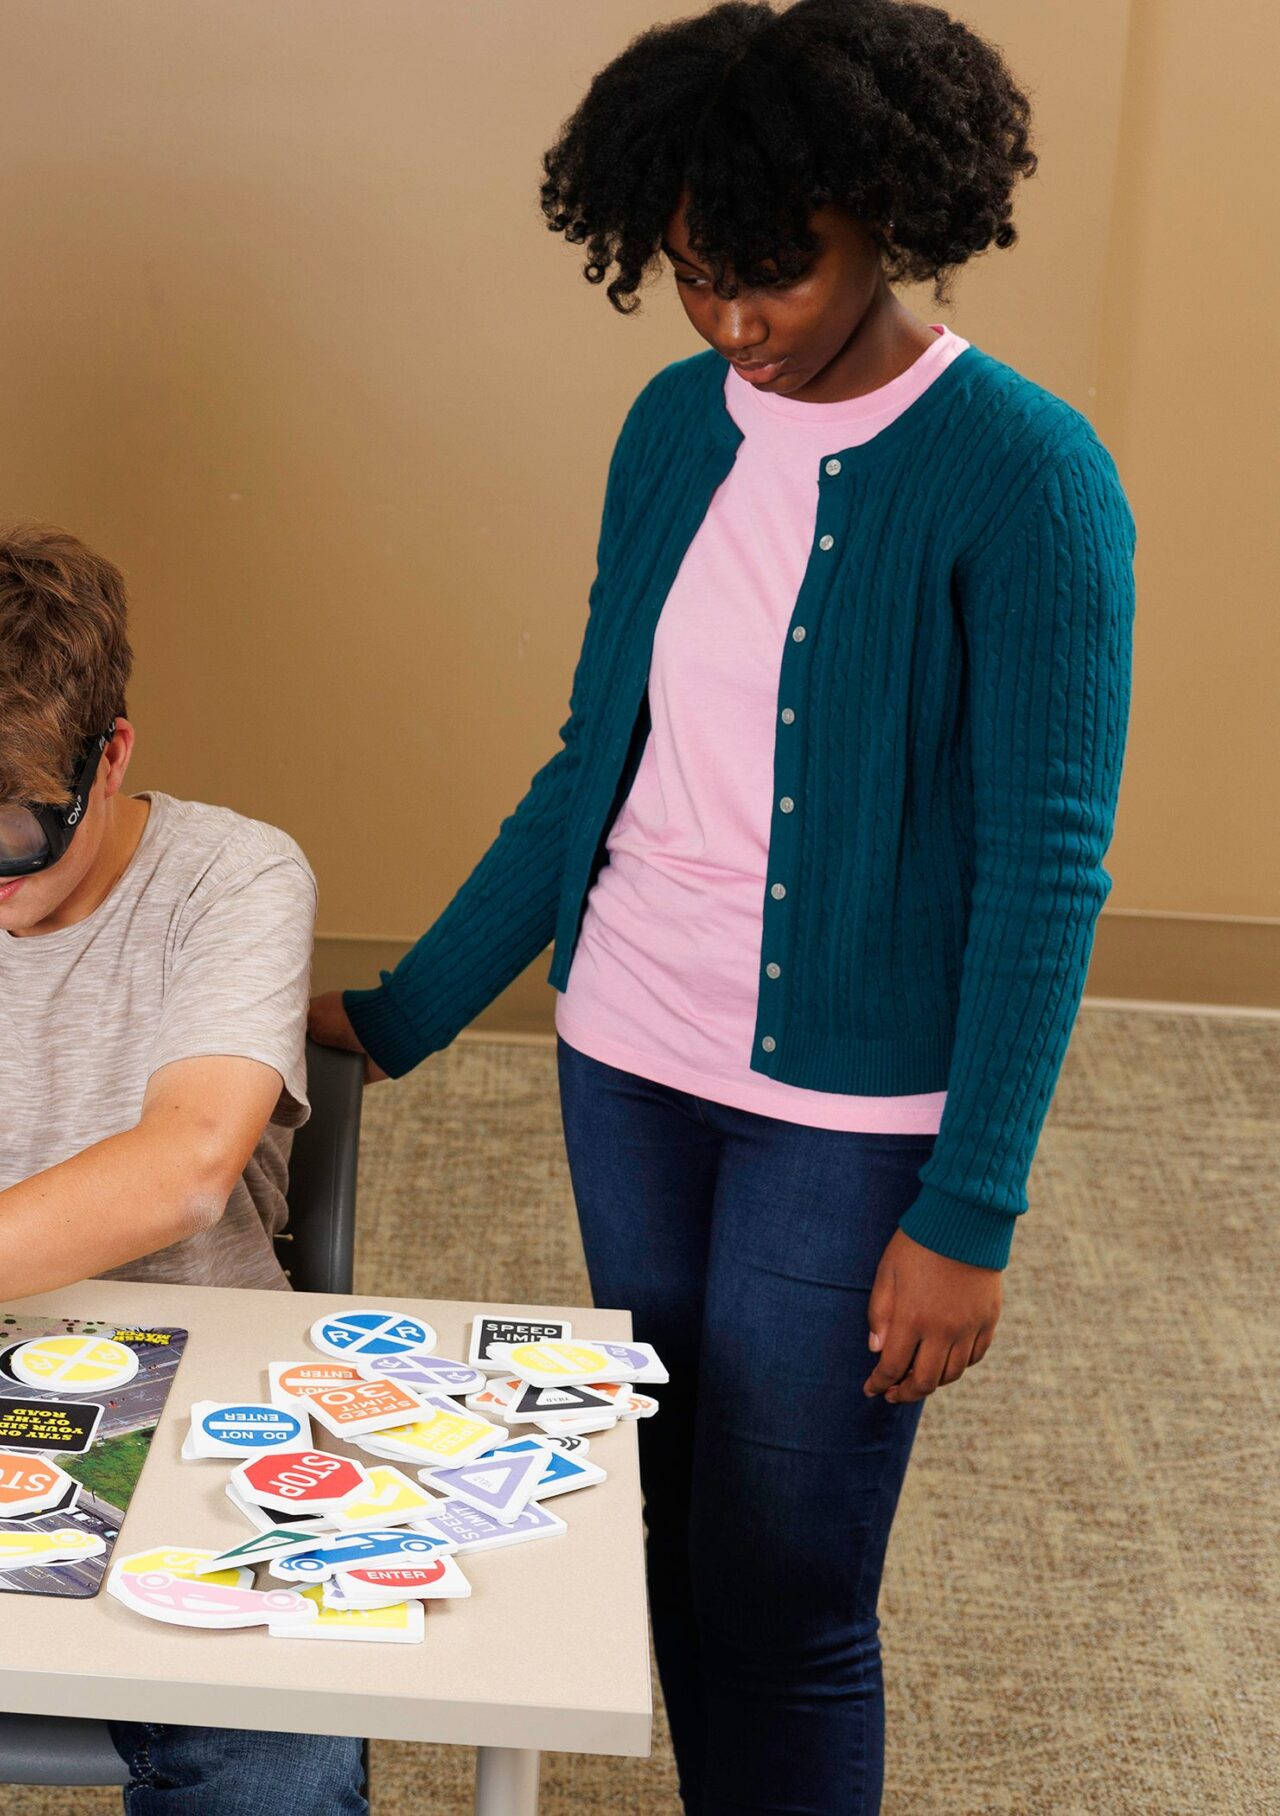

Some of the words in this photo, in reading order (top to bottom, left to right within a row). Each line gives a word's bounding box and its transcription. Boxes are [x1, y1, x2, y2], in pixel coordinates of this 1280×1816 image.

[327, 1330, 353, 1342] R
[396, 1326, 421, 1338] R
[486, 1323, 558, 1336] SPEED
[300, 1370, 353, 1379] ENTER
[320, 1383, 392, 1405] 30
[342, 1395, 398, 1412] LIMIT
[12, 1408, 67, 1418] ROAD
[338, 1400, 412, 1420] SPEED
[3, 1414, 41, 1424] THE
[224, 1413, 279, 1422] ENTER
[32, 1425, 84, 1434] YOUR
[25, 1431, 73, 1441] STAY
[220, 1431, 254, 1439] NOT
[263, 1431, 287, 1440] DO
[268, 1456, 341, 1497] STOP
[451, 1507, 497, 1533] LIMIT
[437, 1512, 480, 1540] SPEE
[366, 1570, 426, 1580] ENTER
